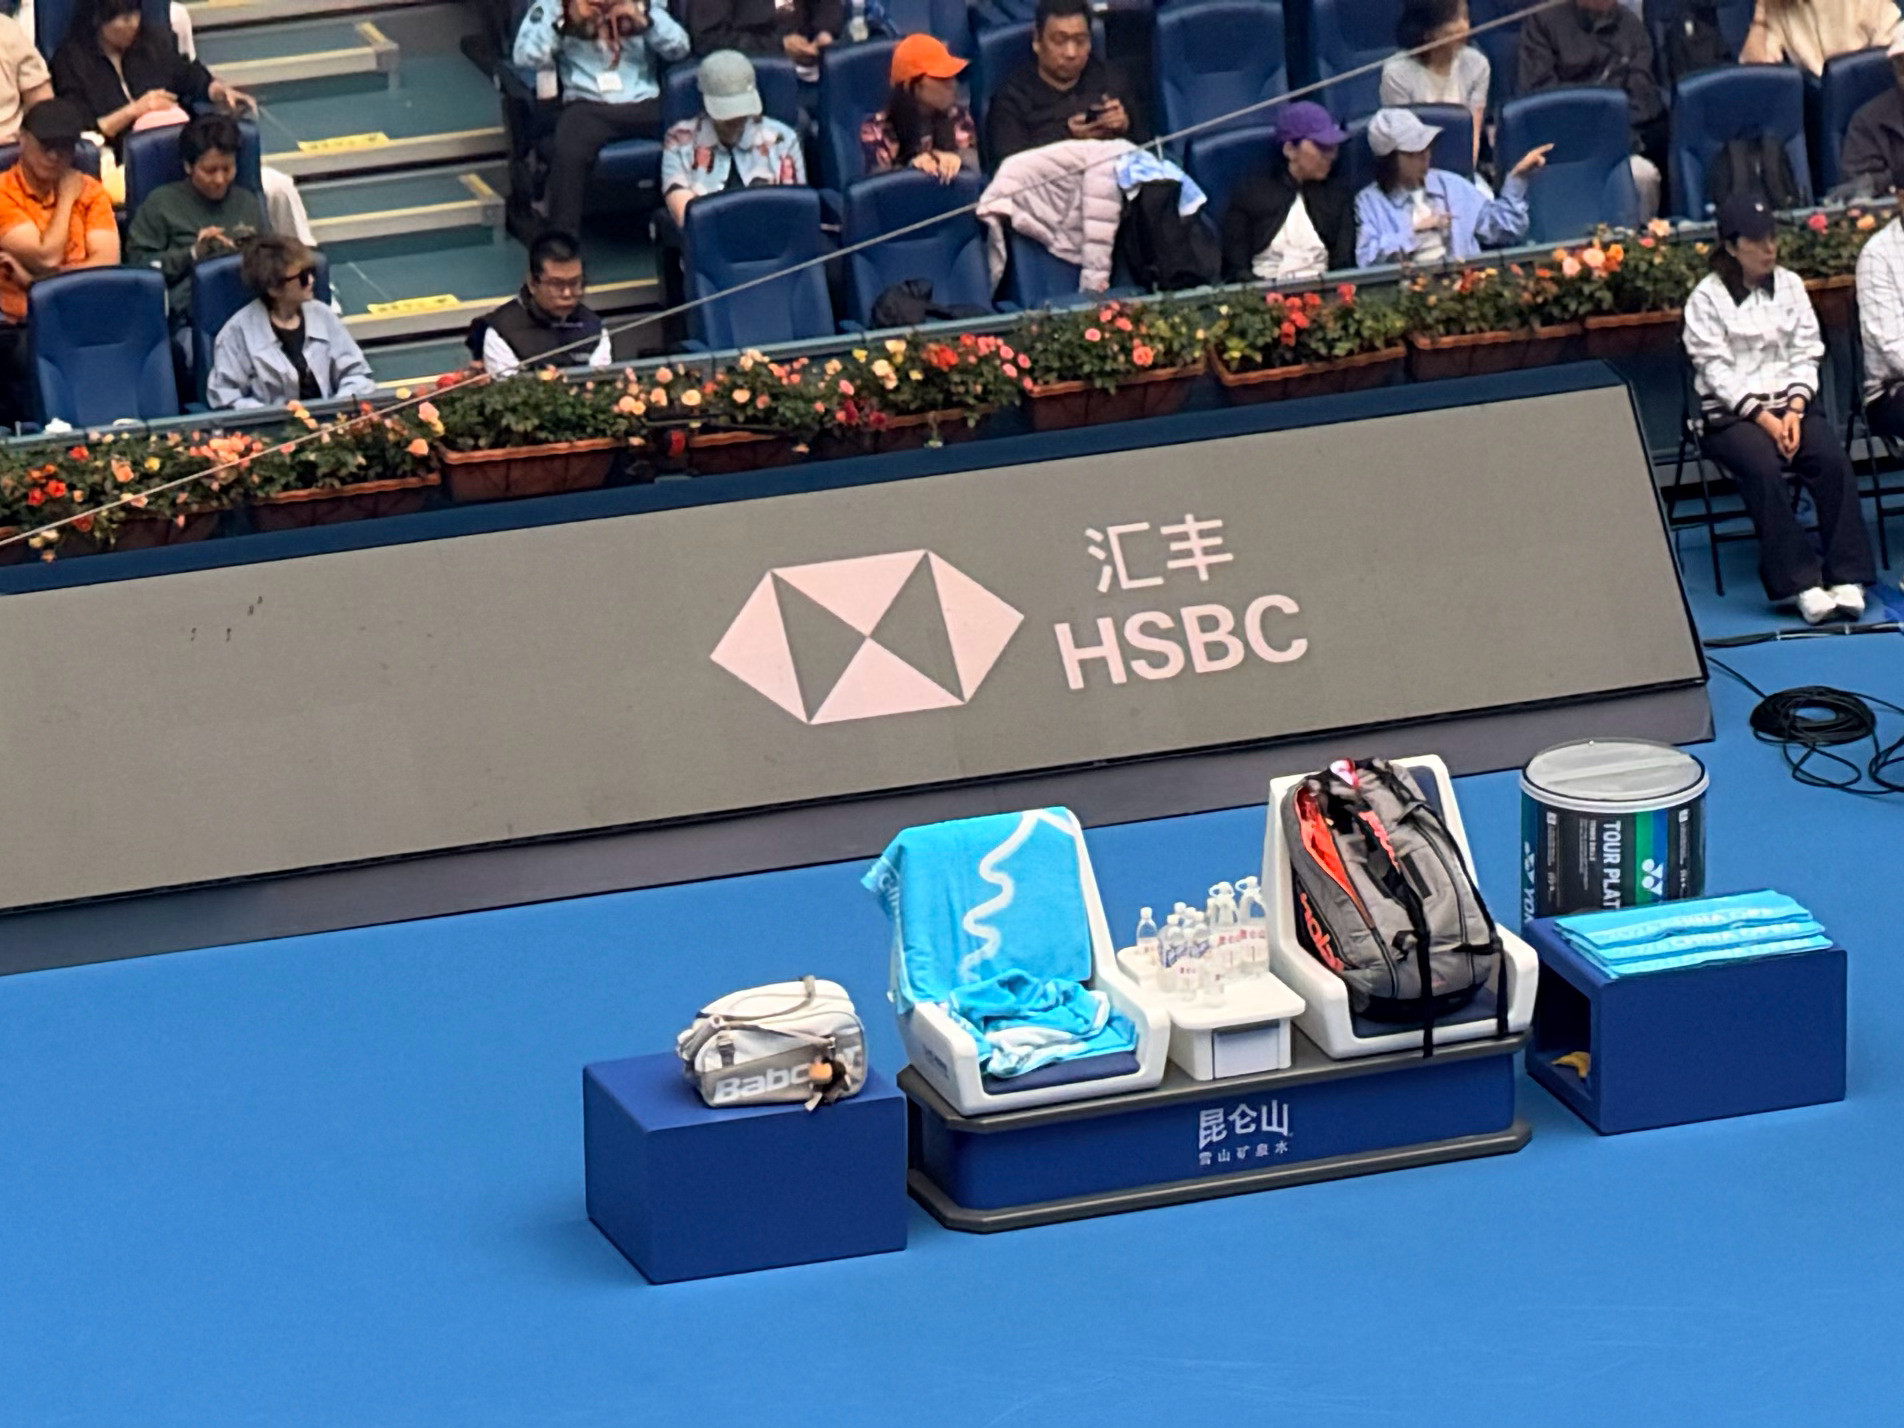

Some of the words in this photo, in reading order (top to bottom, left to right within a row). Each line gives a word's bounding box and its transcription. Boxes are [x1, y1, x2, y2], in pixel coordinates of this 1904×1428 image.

[1085, 513, 1234, 593] 汇丰
[1053, 594, 1308, 690] HSBC
[1603, 820, 1621, 864] TOUR
[713, 1058, 824, 1104] Babo
[1198, 1099, 1290, 1150] 昆仑山
